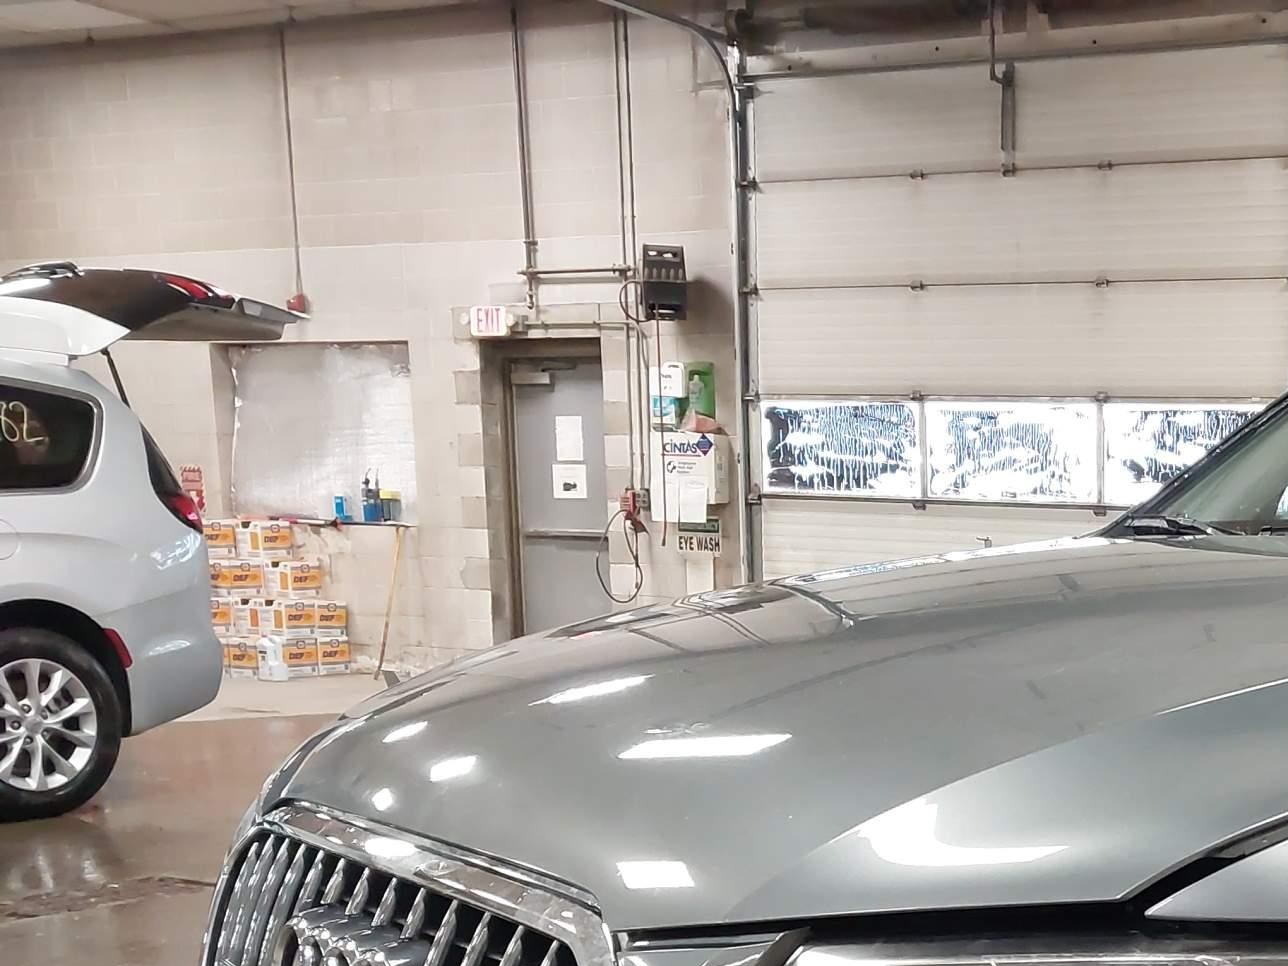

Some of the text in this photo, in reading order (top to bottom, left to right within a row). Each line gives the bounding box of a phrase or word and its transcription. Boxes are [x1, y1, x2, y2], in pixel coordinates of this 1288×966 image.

[477, 308, 501, 332] EXIT
[663, 439, 698, 454] CINTAS
[679, 535, 720, 553] EYE WASH
